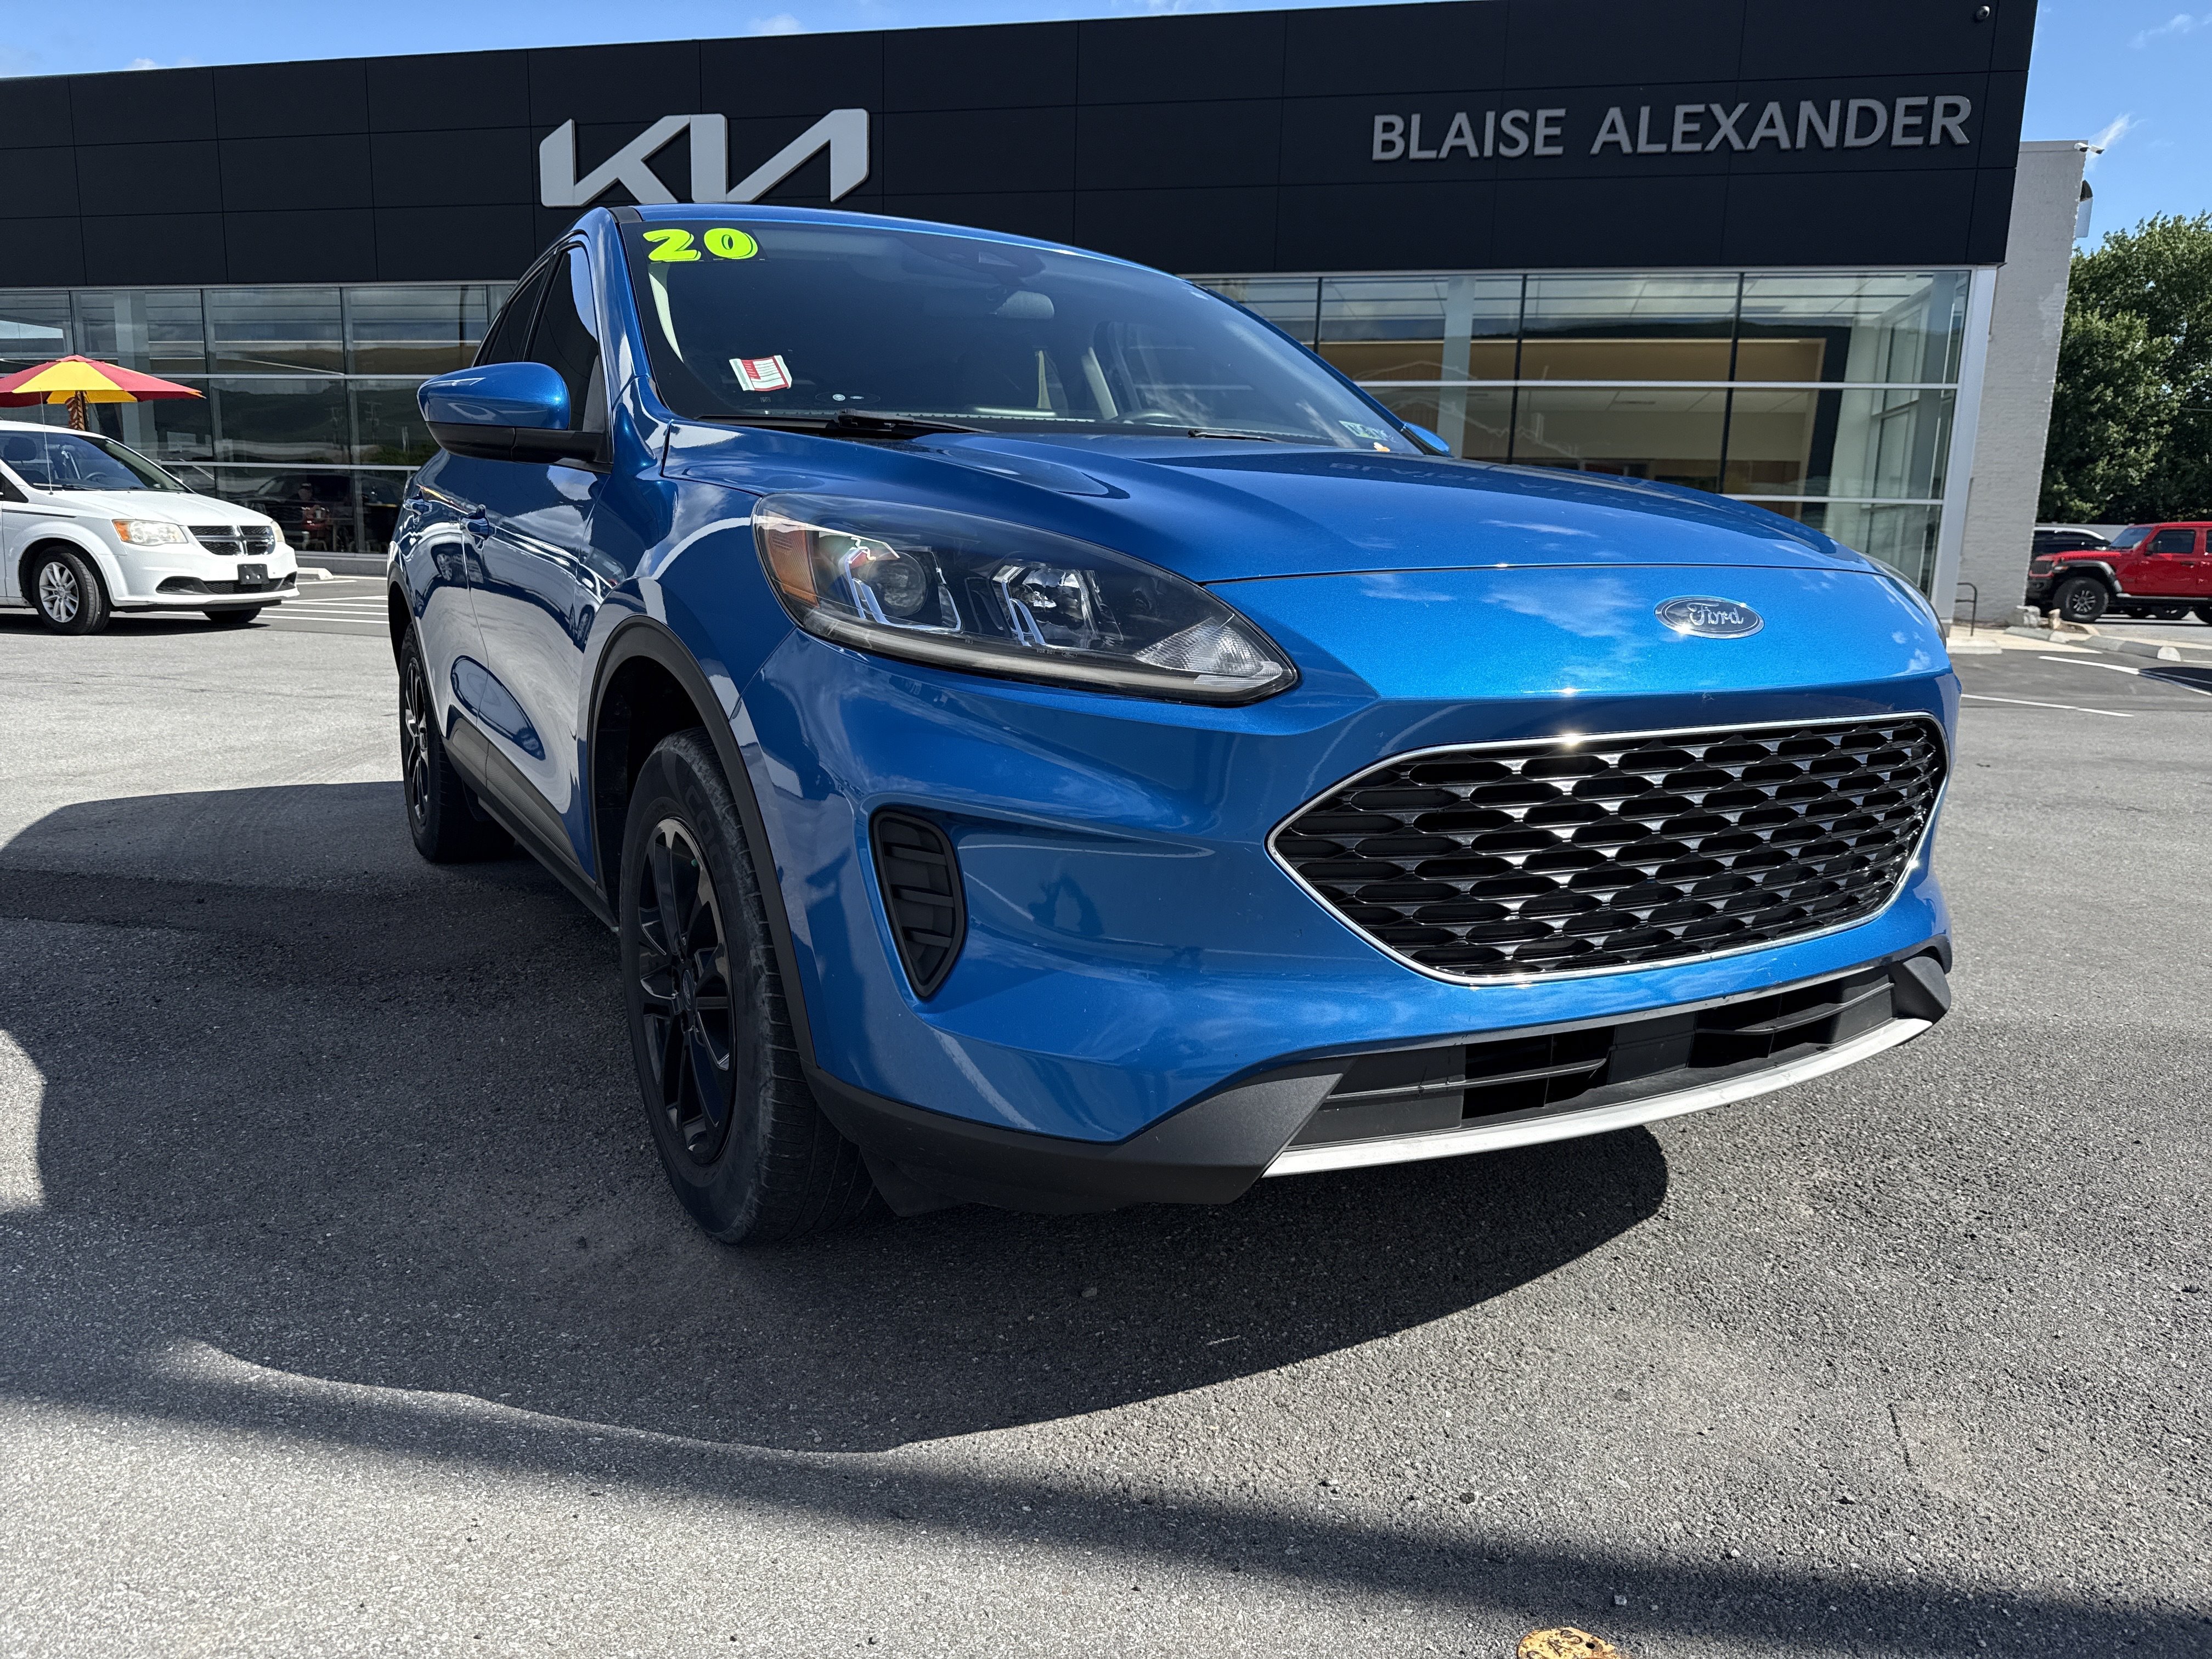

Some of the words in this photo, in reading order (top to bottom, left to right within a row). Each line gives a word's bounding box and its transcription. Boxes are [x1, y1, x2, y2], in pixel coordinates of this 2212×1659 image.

[1372, 109, 1566, 161] BLAISE
[1589, 95, 1972, 155] ALEXANDER
[539, 108, 870, 207] KIA
[642, 227, 758, 262] 20
[1686, 602, 1744, 626] Ford
[1526, 1629, 1583, 1659] AS
